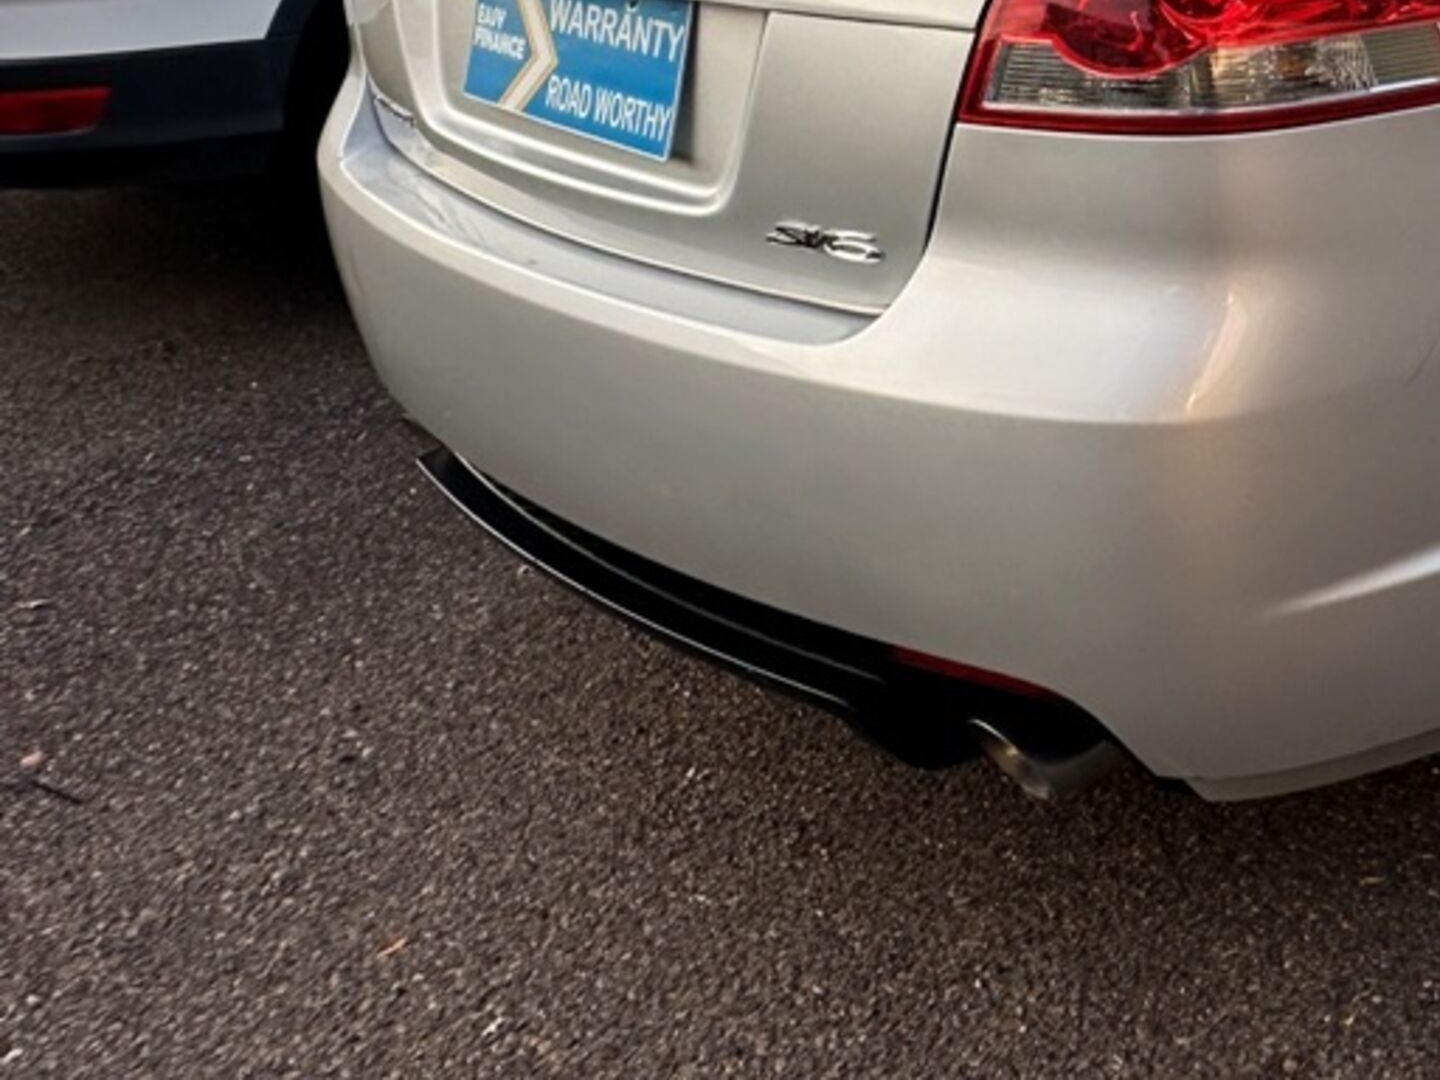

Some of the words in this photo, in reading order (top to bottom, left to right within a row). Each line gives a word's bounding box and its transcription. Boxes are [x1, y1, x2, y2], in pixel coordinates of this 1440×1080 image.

[473, 27, 528, 62] FINANCE
[545, 74, 593, 121] ROAD
[594, 88, 671, 143] WORTHY
